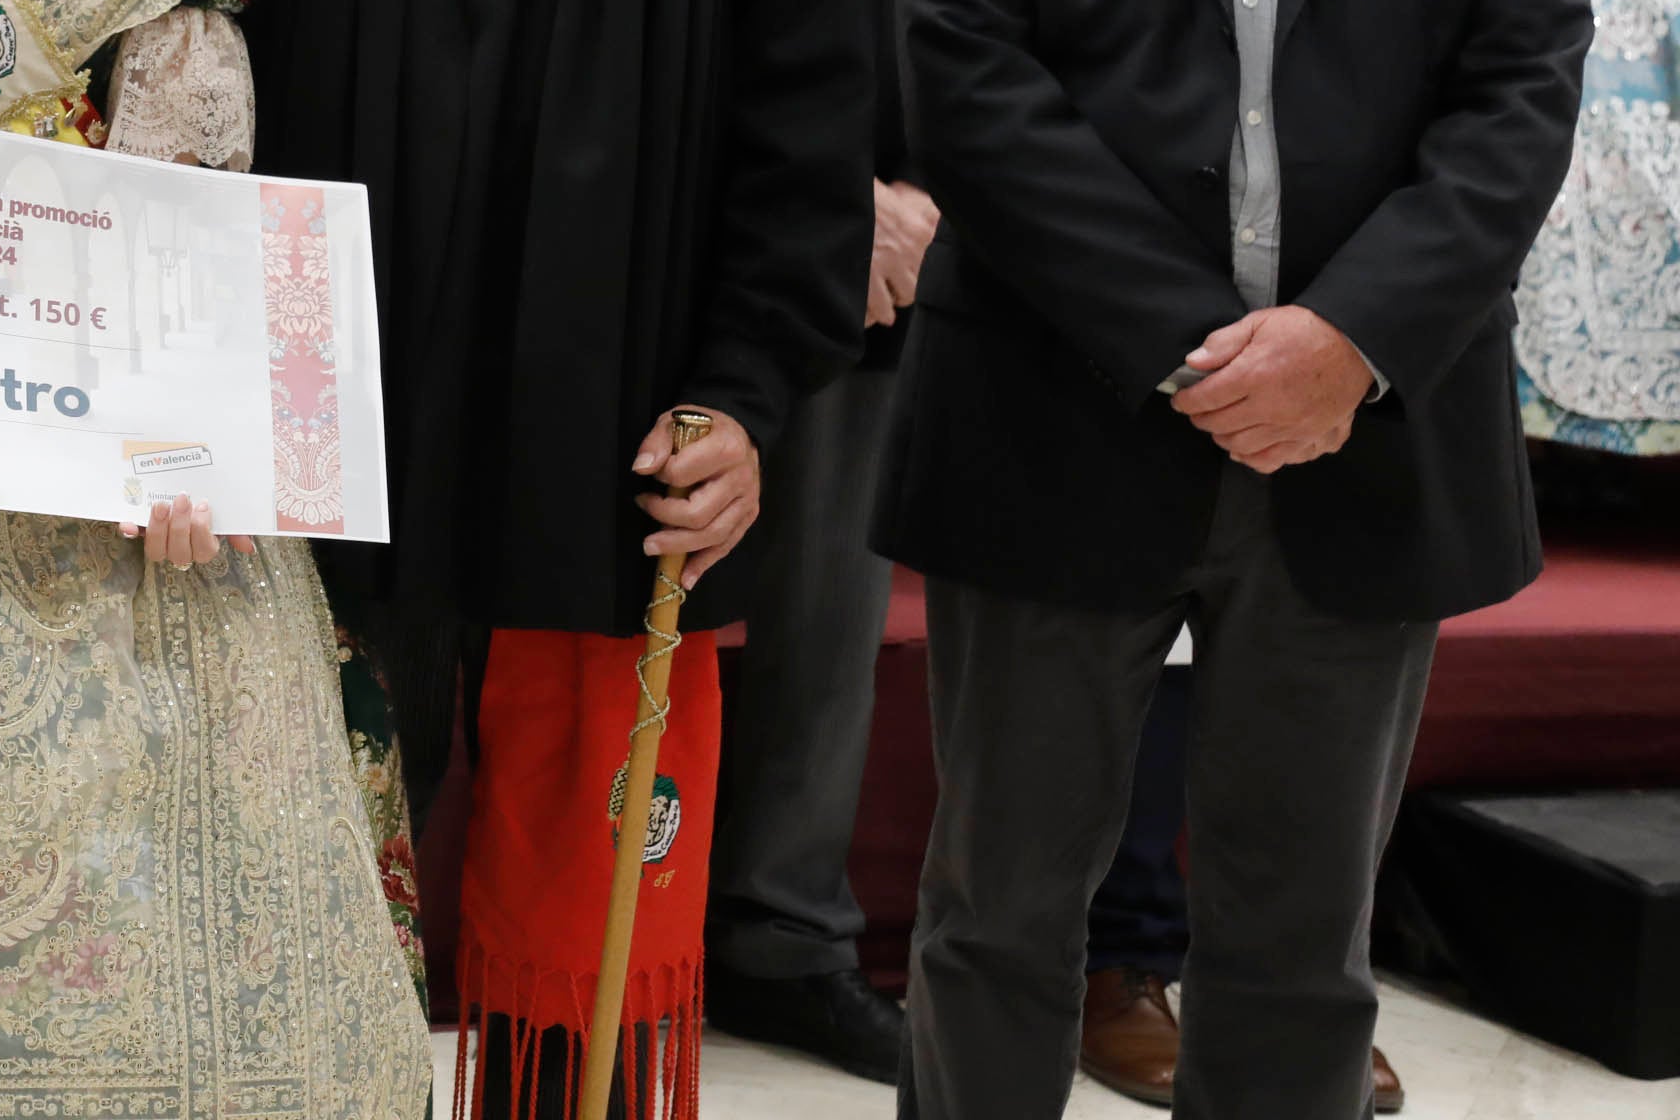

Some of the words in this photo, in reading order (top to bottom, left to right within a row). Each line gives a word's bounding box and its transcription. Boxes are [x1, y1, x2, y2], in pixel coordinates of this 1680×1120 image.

[9, 199, 113, 230] promoció
[29, 298, 81, 326] 150
[90, 307, 107, 330] €
